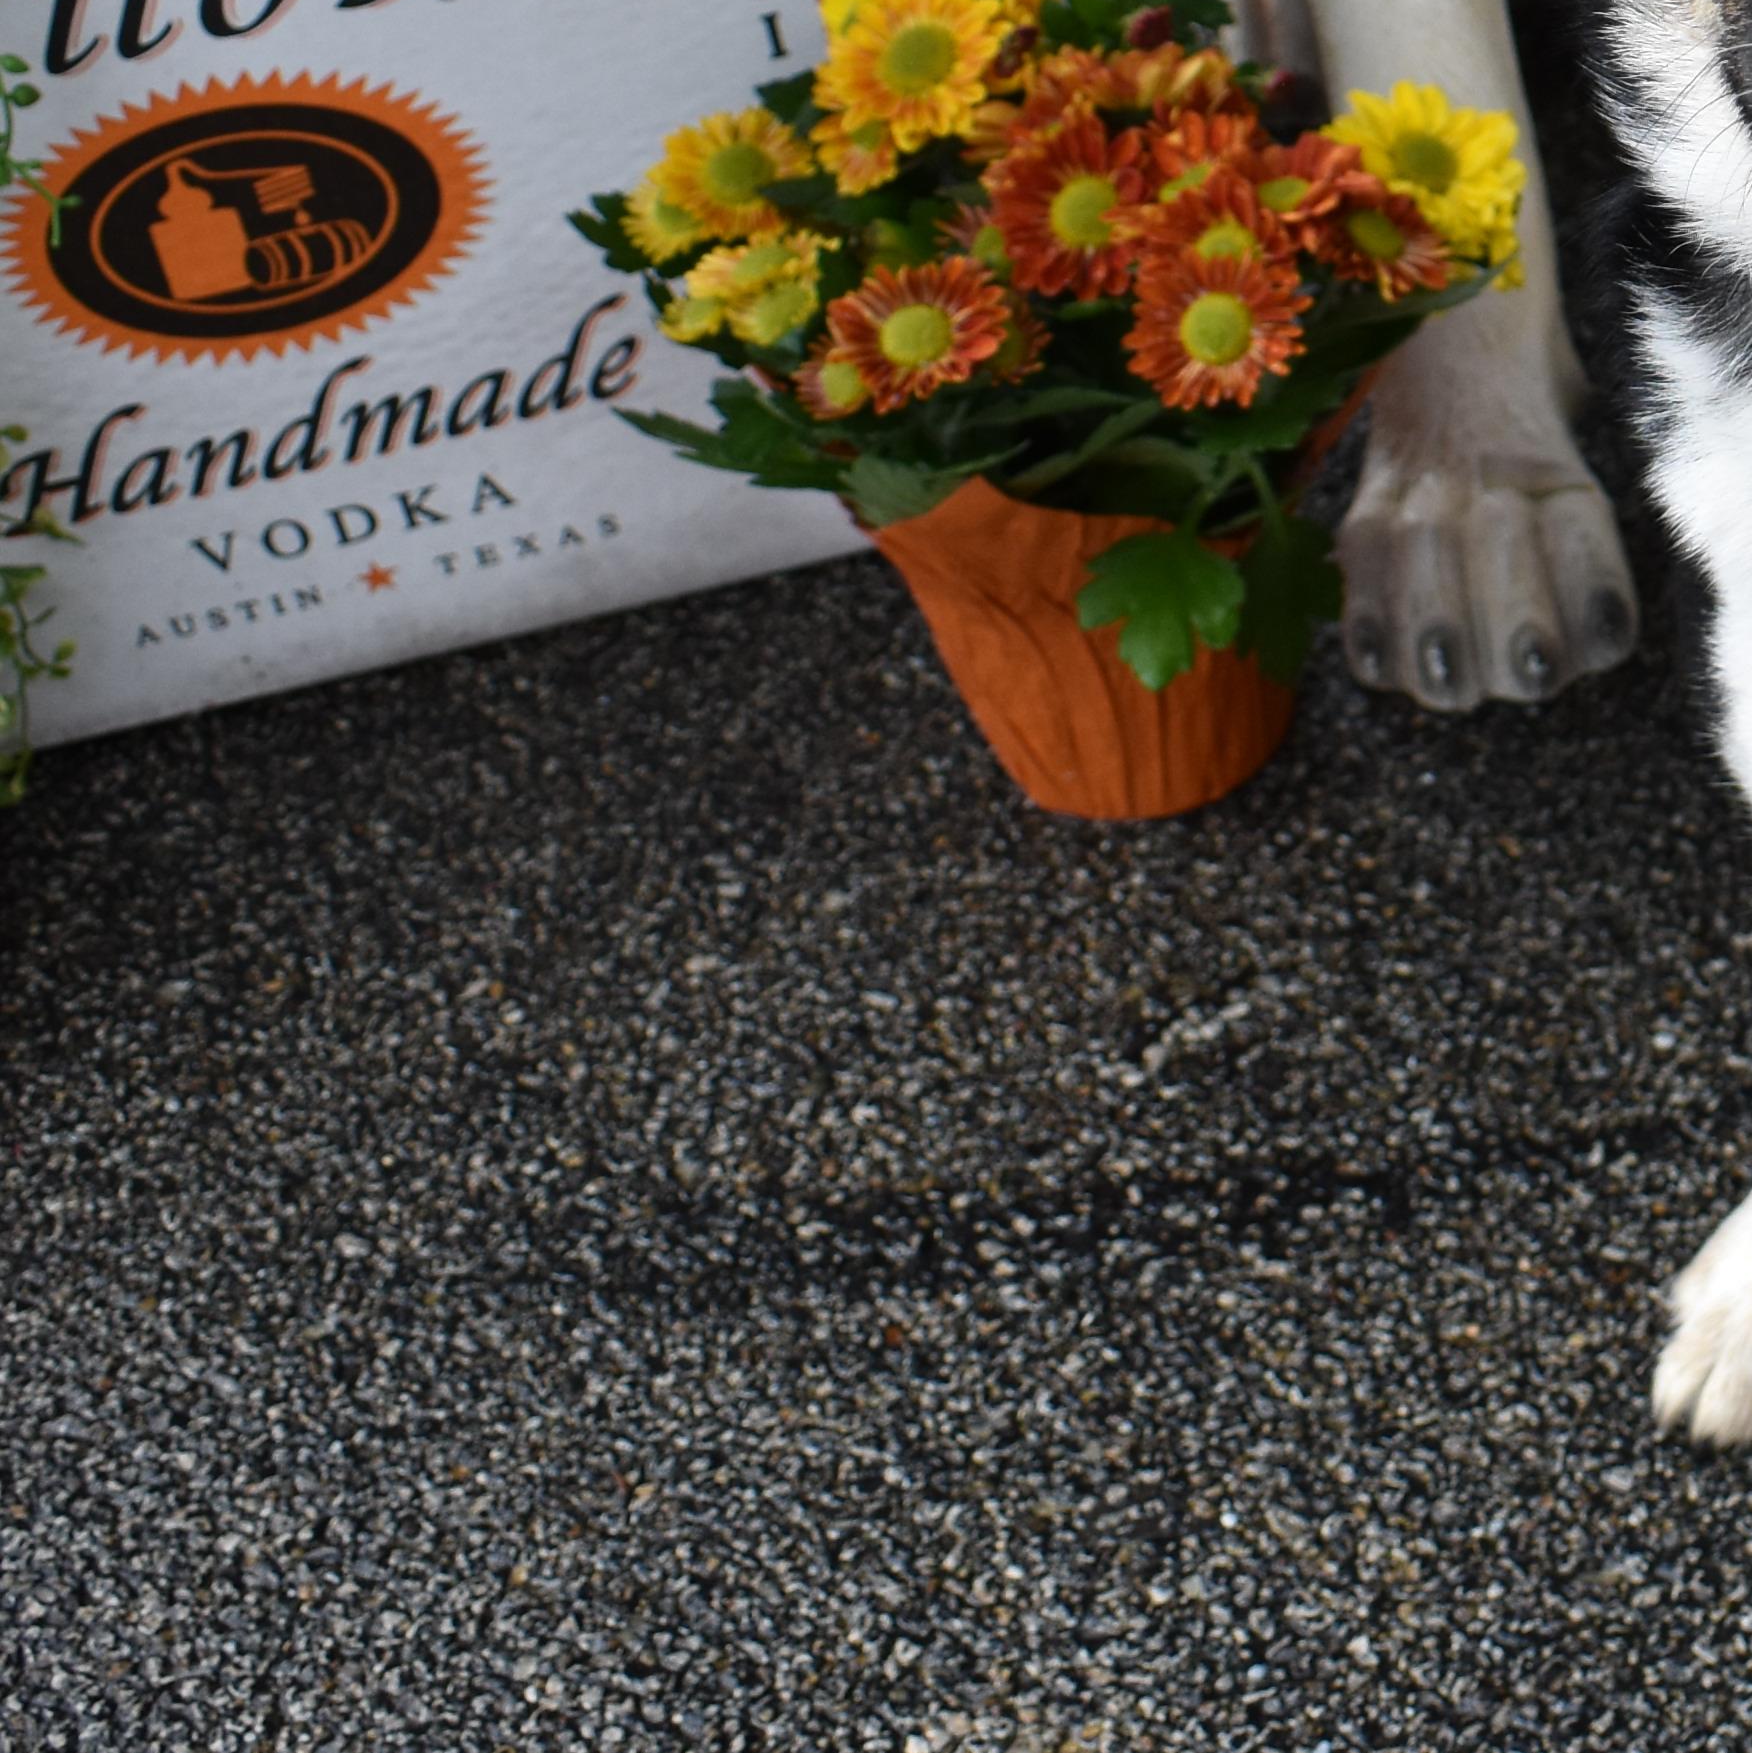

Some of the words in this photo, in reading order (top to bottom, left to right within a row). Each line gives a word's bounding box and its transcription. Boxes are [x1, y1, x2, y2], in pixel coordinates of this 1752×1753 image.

[0, 293, 643, 537] Handmade
[135, 584, 324, 648] AUSTIN
[434, 512, 624, 578] TEXAS
[192, 472, 517, 573] VODKA
